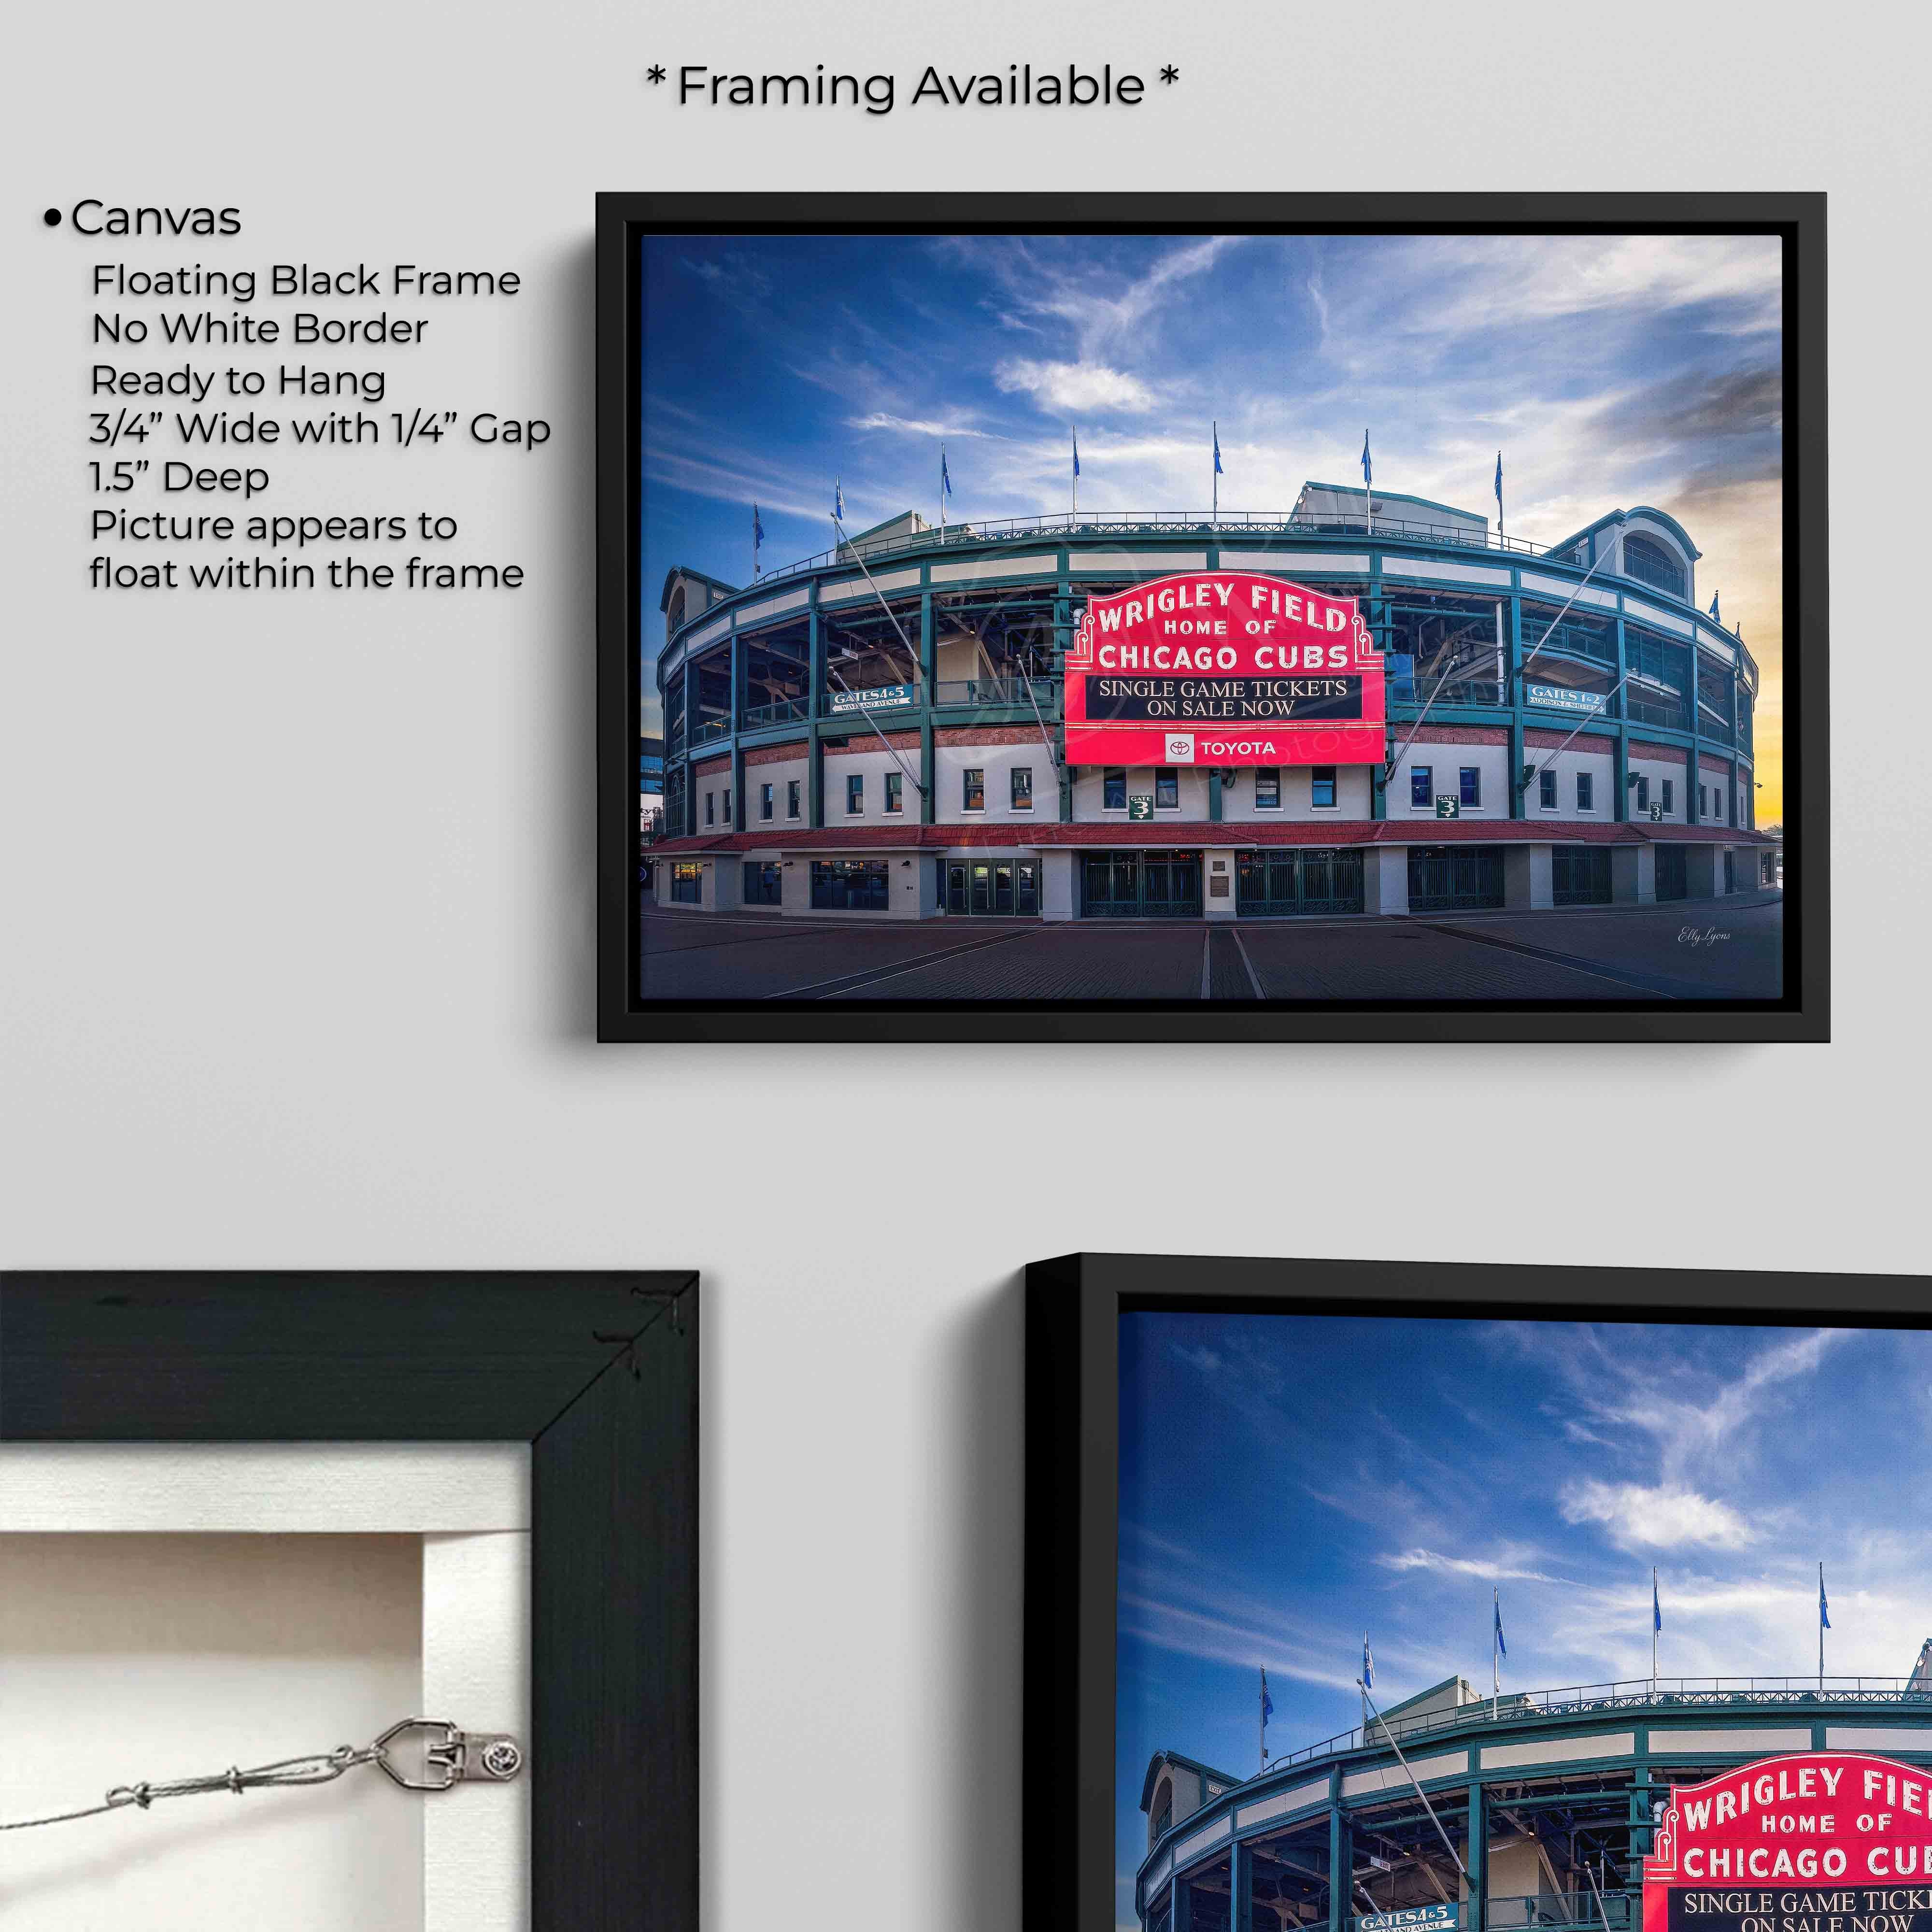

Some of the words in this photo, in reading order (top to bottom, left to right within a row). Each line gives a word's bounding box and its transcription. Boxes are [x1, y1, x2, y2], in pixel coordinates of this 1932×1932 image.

[1099, 583, 1235, 632] WRIGLEY
[1252, 585, 1347, 632] FIELD
[1165, 620, 1227, 635] HOME
[1245, 620, 1277, 634] OF
[1099, 645, 1237, 670] CHICAGO
[1255, 645, 1348, 670] CUBS
[835, 690, 879, 704] GATES
[1100, 681, 1175, 697] SINGLE
[1180, 681, 1244, 697] GAME
[1252, 680, 1348, 697] TICKETS
[1532, 687, 1577, 701] GATES
[1147, 700, 1179, 716] ON
[1183, 700, 1235, 716] SALE
[1241, 699, 1295, 715] NOW
[1201, 741, 1276, 755] TOYOTA
[1134, 801, 1149, 815] 3
[1441, 800, 1455, 813] 3
[1653, 806, 1660, 817] 3
[1683, 1767, 1845, 1832] WRIGLEY
[1863, 1769, 1932, 1820] FIE
[1762, 1815, 1834, 1833] HOME
[1856, 1813, 1892, 1832] OF
[1684, 1847, 1847, 1878] CHICAGO
[1685, 1893, 1774, 1914] SINGLE
[1780, 1893, 1856, 1913] GAME
[1361, 1911, 1417, 1929] GATES
[1414, 1922, 1444, 1932] AVENUE
[1741, 1918, 1776, 1932] ON
[1782, 1917, 1844, 1932] SALE
[1851, 1915, 1914, 1932] NOW
